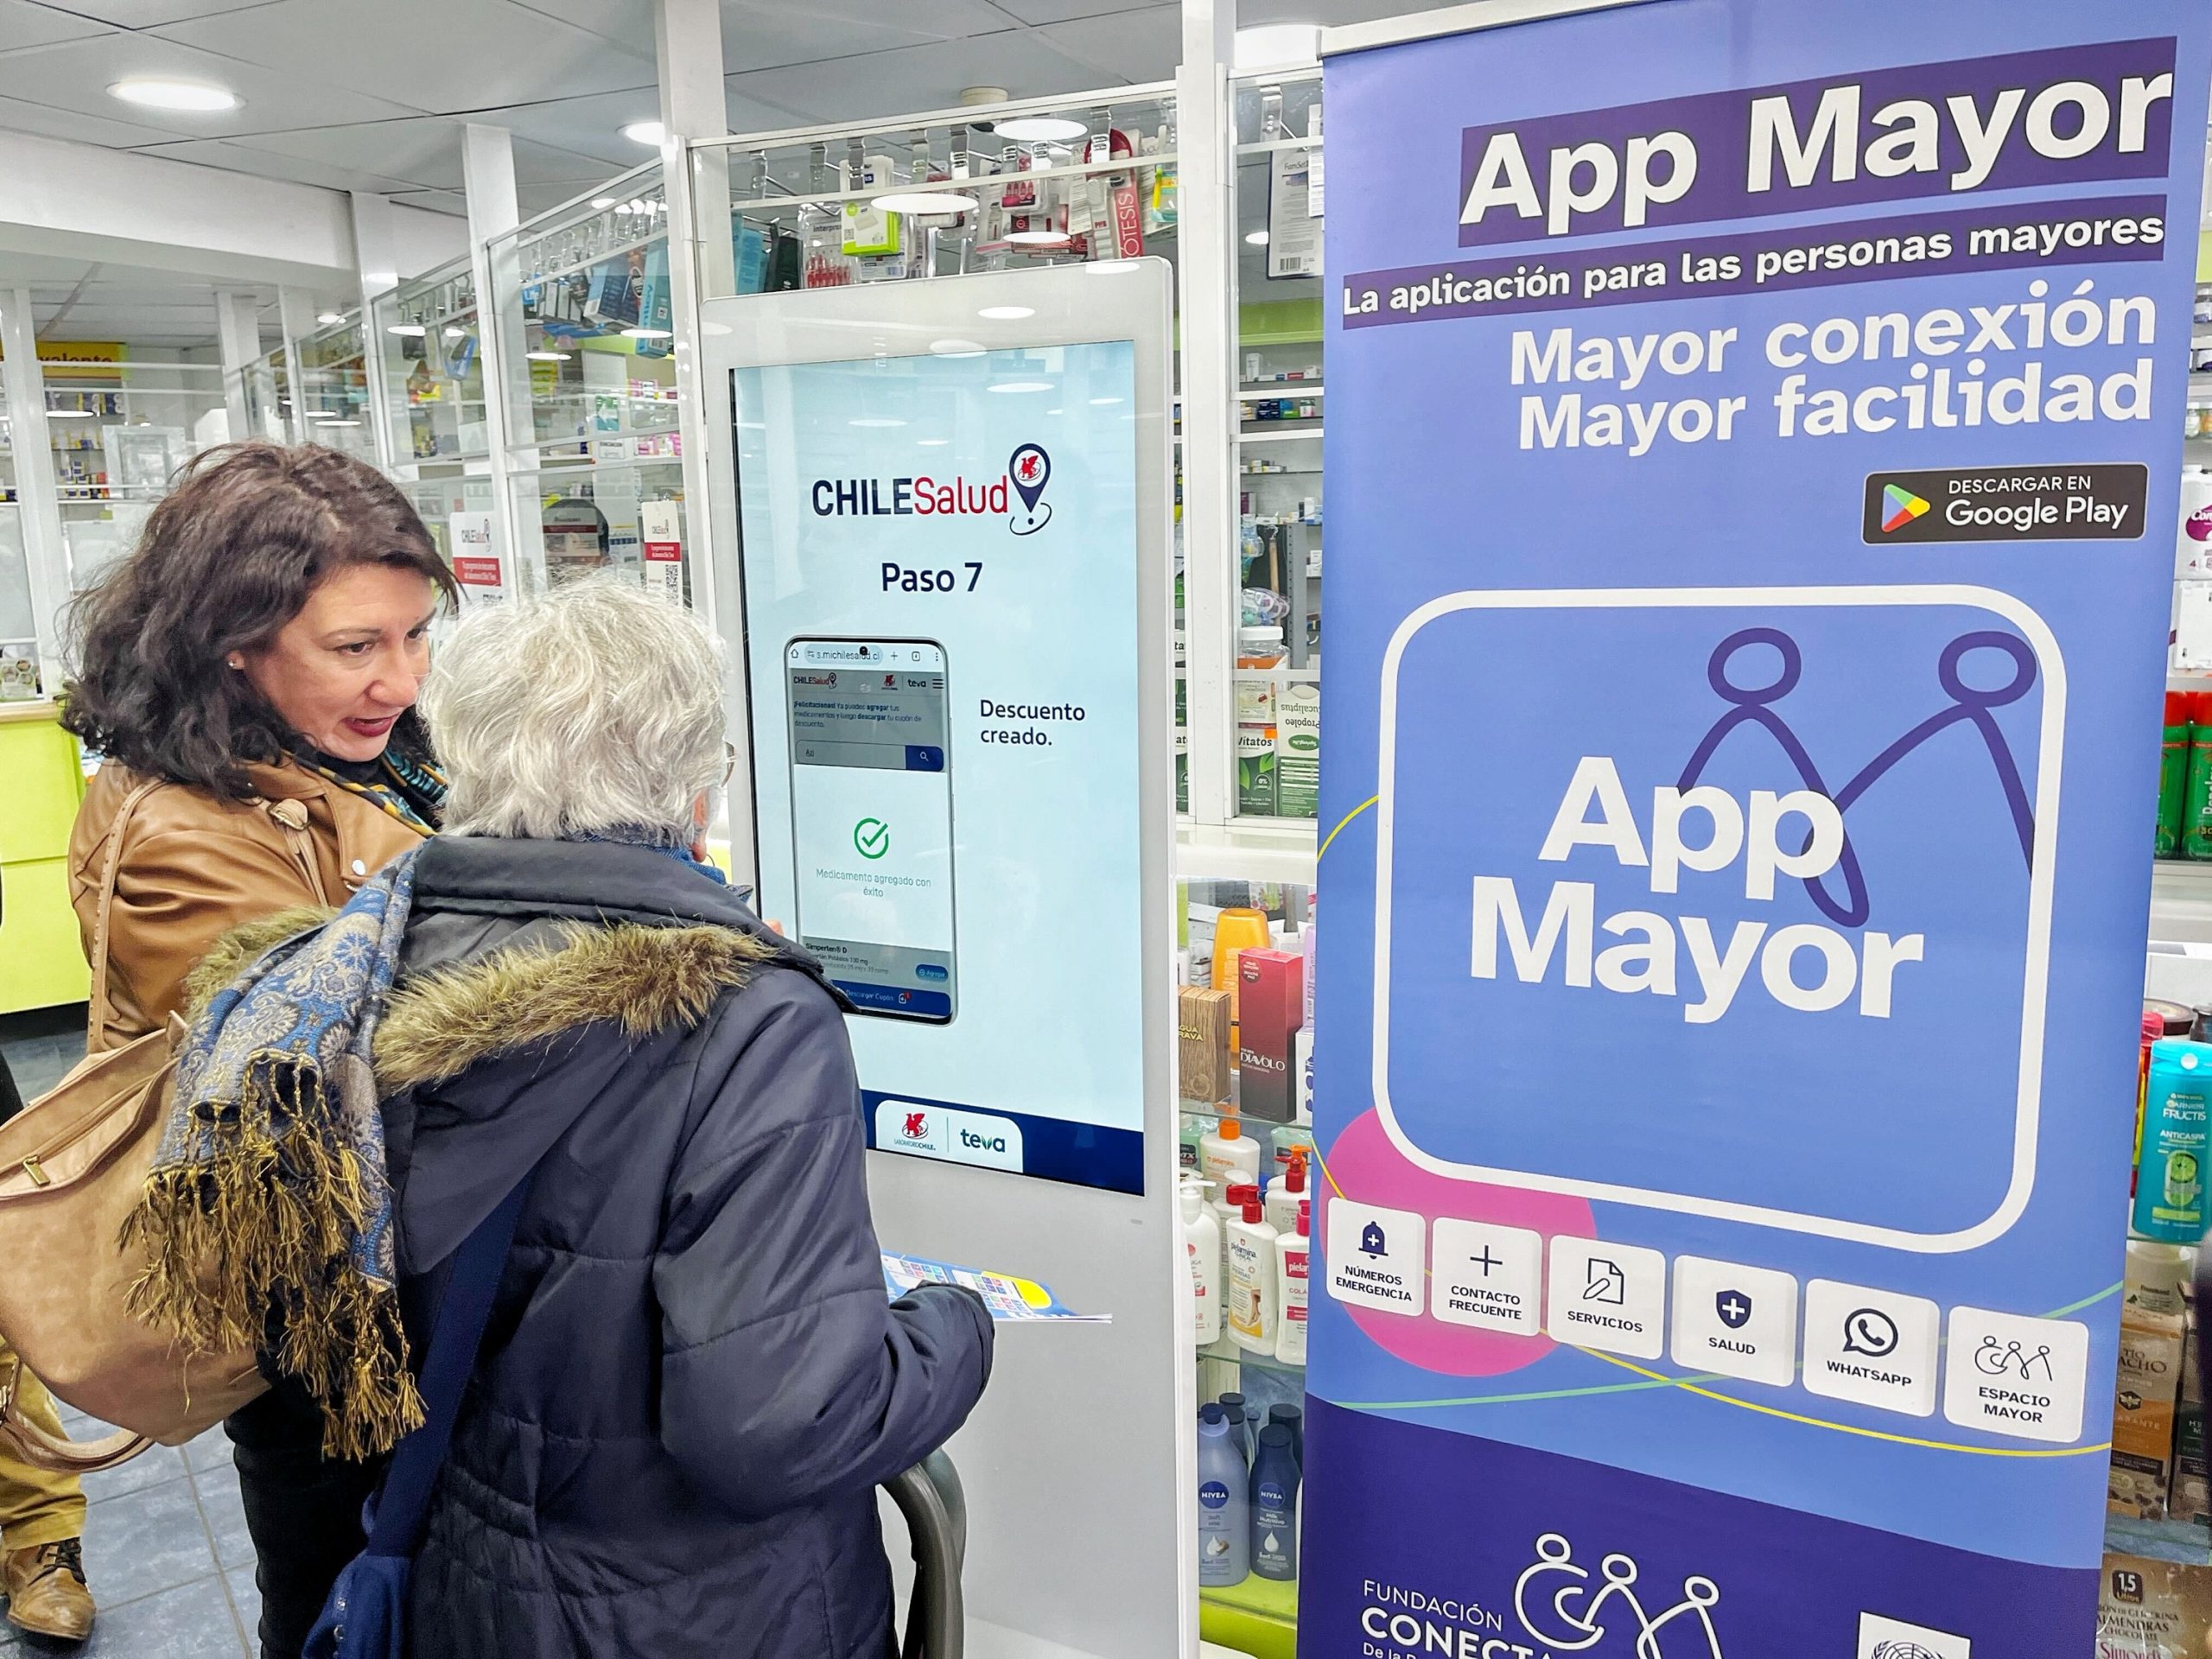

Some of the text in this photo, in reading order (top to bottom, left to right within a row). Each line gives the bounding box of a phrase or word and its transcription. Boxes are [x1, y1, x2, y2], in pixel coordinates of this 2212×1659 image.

[1459, 69, 2173, 235] App Mayor
[1343, 213, 2165, 318] La aplicación para las personas mayores
[1510, 279, 2156, 391] Mayor conexión
[1518, 359, 2152, 457] Mayor facilidad
[1948, 474, 2092, 494] DESCARGAR EN
[812, 475, 1007, 517] CHILESalud
[1945, 496, 2129, 532] Google Play
[881, 562, 984, 593] Paso 7
[907, 678, 926, 688] teva
[980, 699, 1086, 721] Descuento
[980, 727, 1053, 747] creado.
[1538, 756, 1844, 900] App
[816, 868, 932, 887] Medicamento agregado con
[862, 887, 884, 899] éxito
[1471, 874, 1924, 1025] Mayor
[1179, 1025, 1198, 1033] GUA
[2163, 1107, 2207, 1121] FRUCTIS
[960, 1128, 1006, 1154] teva
[2160, 1128, 2206, 1141] ANTICASPA
[1344, 1264, 1403, 1287] NÚMEROS
[1335, 1278, 1413, 1303] EMERGENCIA
[1450, 1284, 1521, 1306] CONTACTO
[1448, 1298, 1522, 1321] FRECUENTE
[1567, 1310, 1643, 1333] SERVICIOS
[1707, 1336, 1756, 1356] SALUD
[1826, 1359, 1912, 1387] WHATSAPP
[2119, 1356, 2167, 1374] ACHO
[1977, 1386, 2051, 1408] ESPACIO
[1983, 1402, 2044, 1424] MAYOR
[1261, 1491, 1283, 1500] NIVEA
[1363, 1579, 1503, 1632] FUNDACIÓN
[1361, 1606, 1552, 1659] CONECT
[2097, 1614, 2170, 1632] ALMENDRAS
